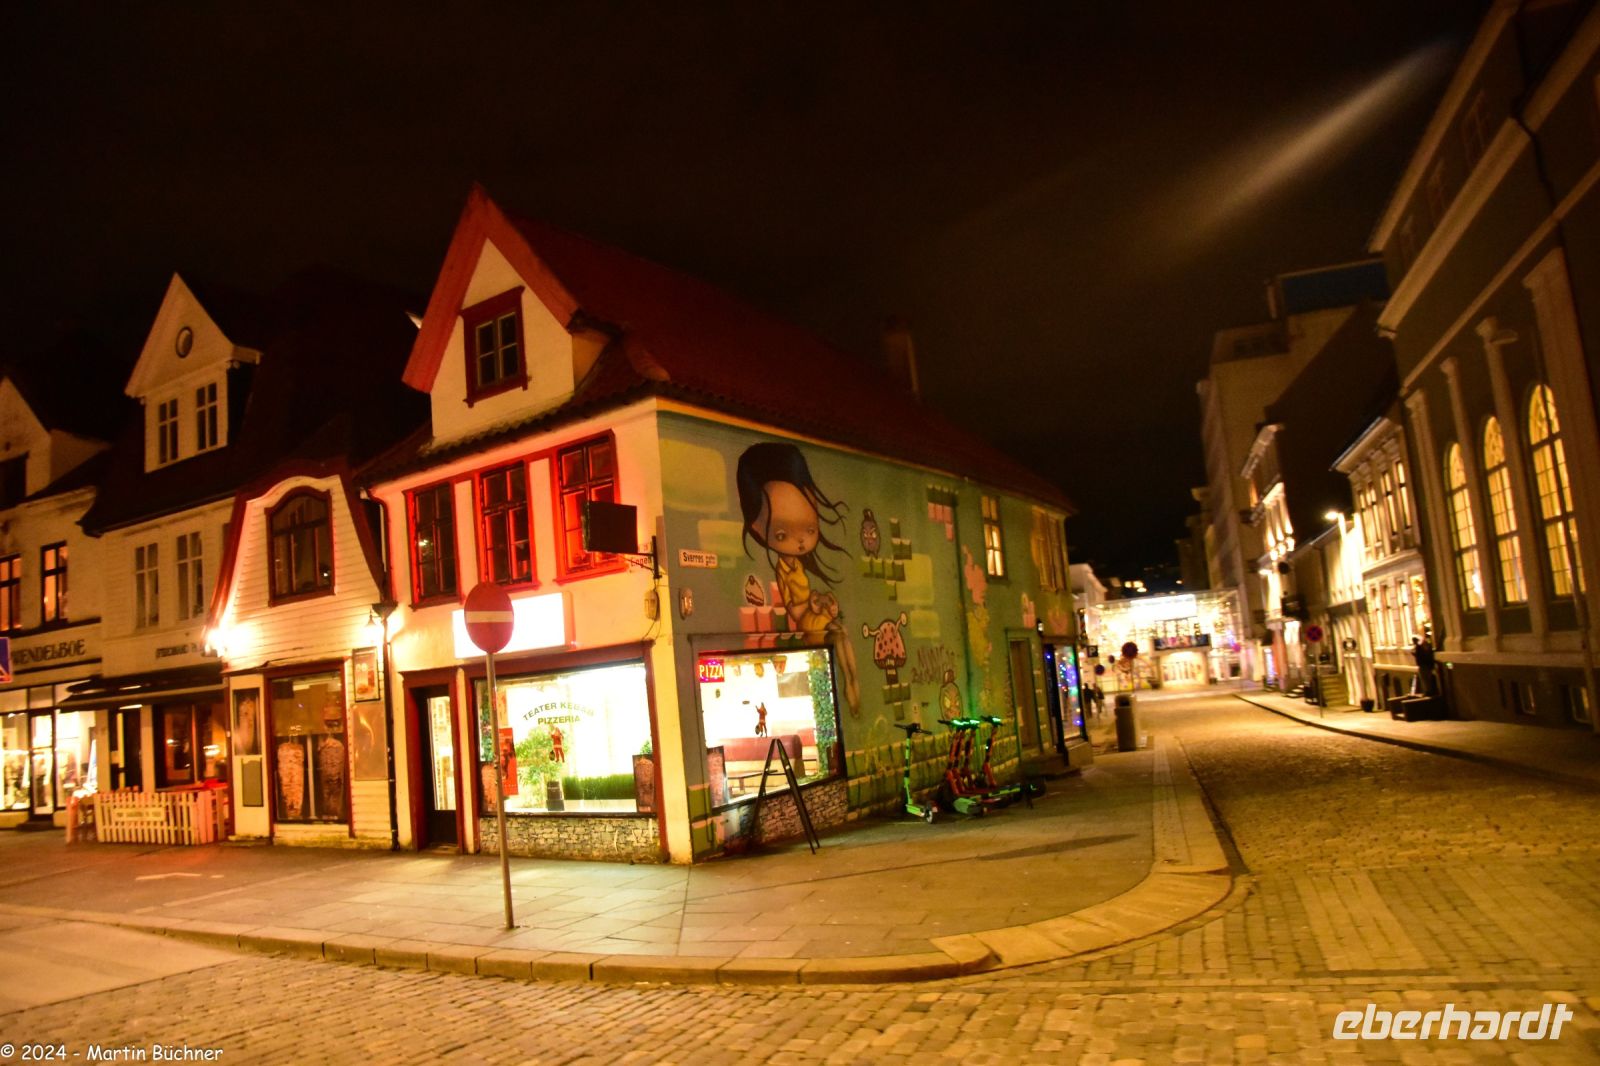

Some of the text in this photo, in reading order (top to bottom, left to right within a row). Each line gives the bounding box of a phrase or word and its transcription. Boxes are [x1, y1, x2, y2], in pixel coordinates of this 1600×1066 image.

[699, 664, 724, 678] PIZZA
[523, 702, 557, 720] TEATER
[537, 715, 581, 725] PIZZERIA
